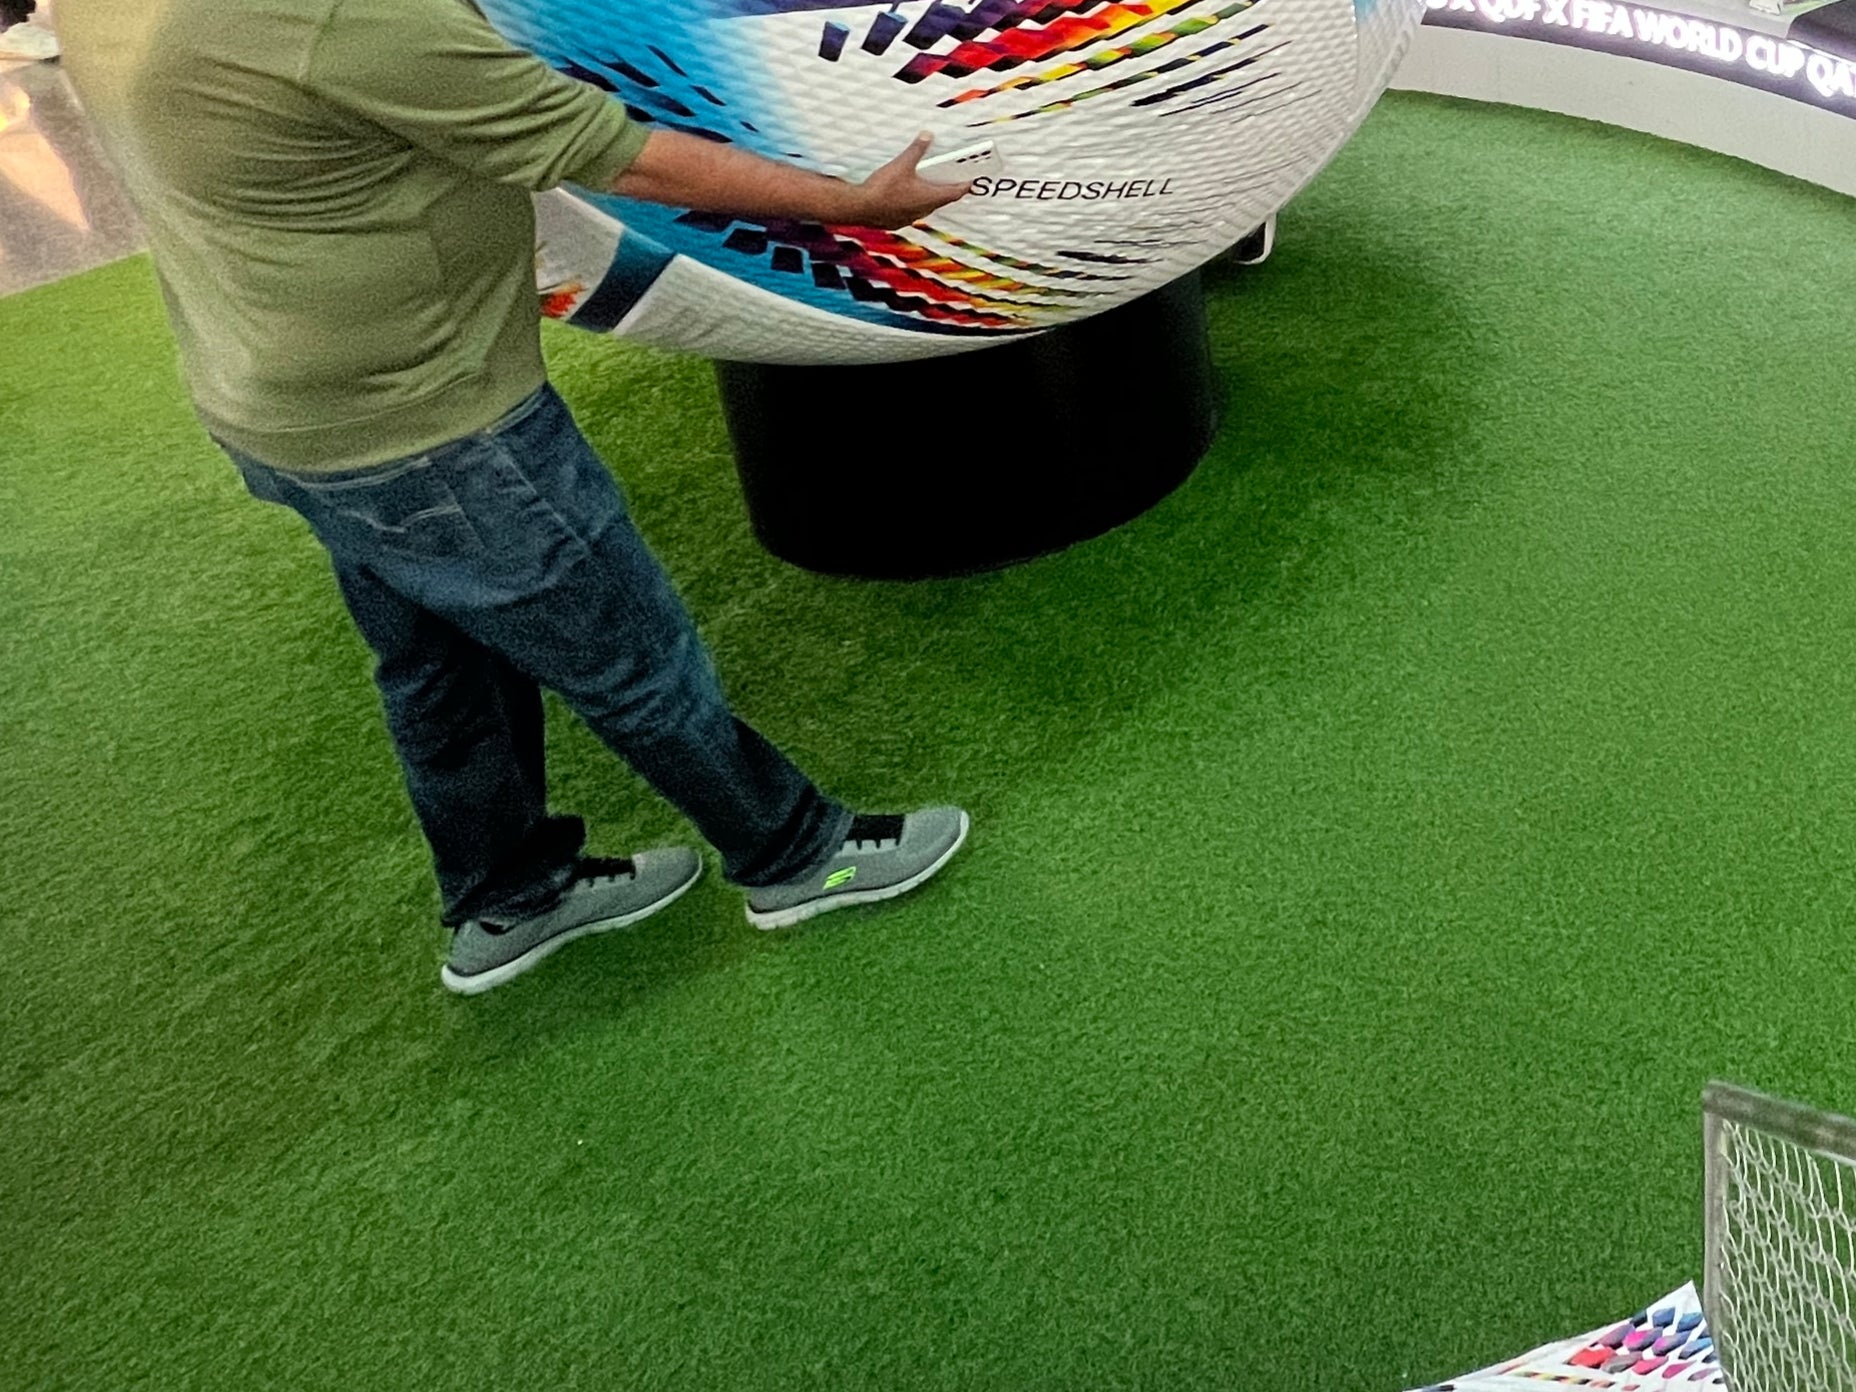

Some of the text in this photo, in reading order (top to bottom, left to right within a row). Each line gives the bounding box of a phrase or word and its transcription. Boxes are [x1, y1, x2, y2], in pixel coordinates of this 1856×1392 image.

[1634, 9, 1743, 62] WORLD
[1746, 35, 1805, 78] CUP
[970, 176, 1174, 200] SPEEDSHELL
